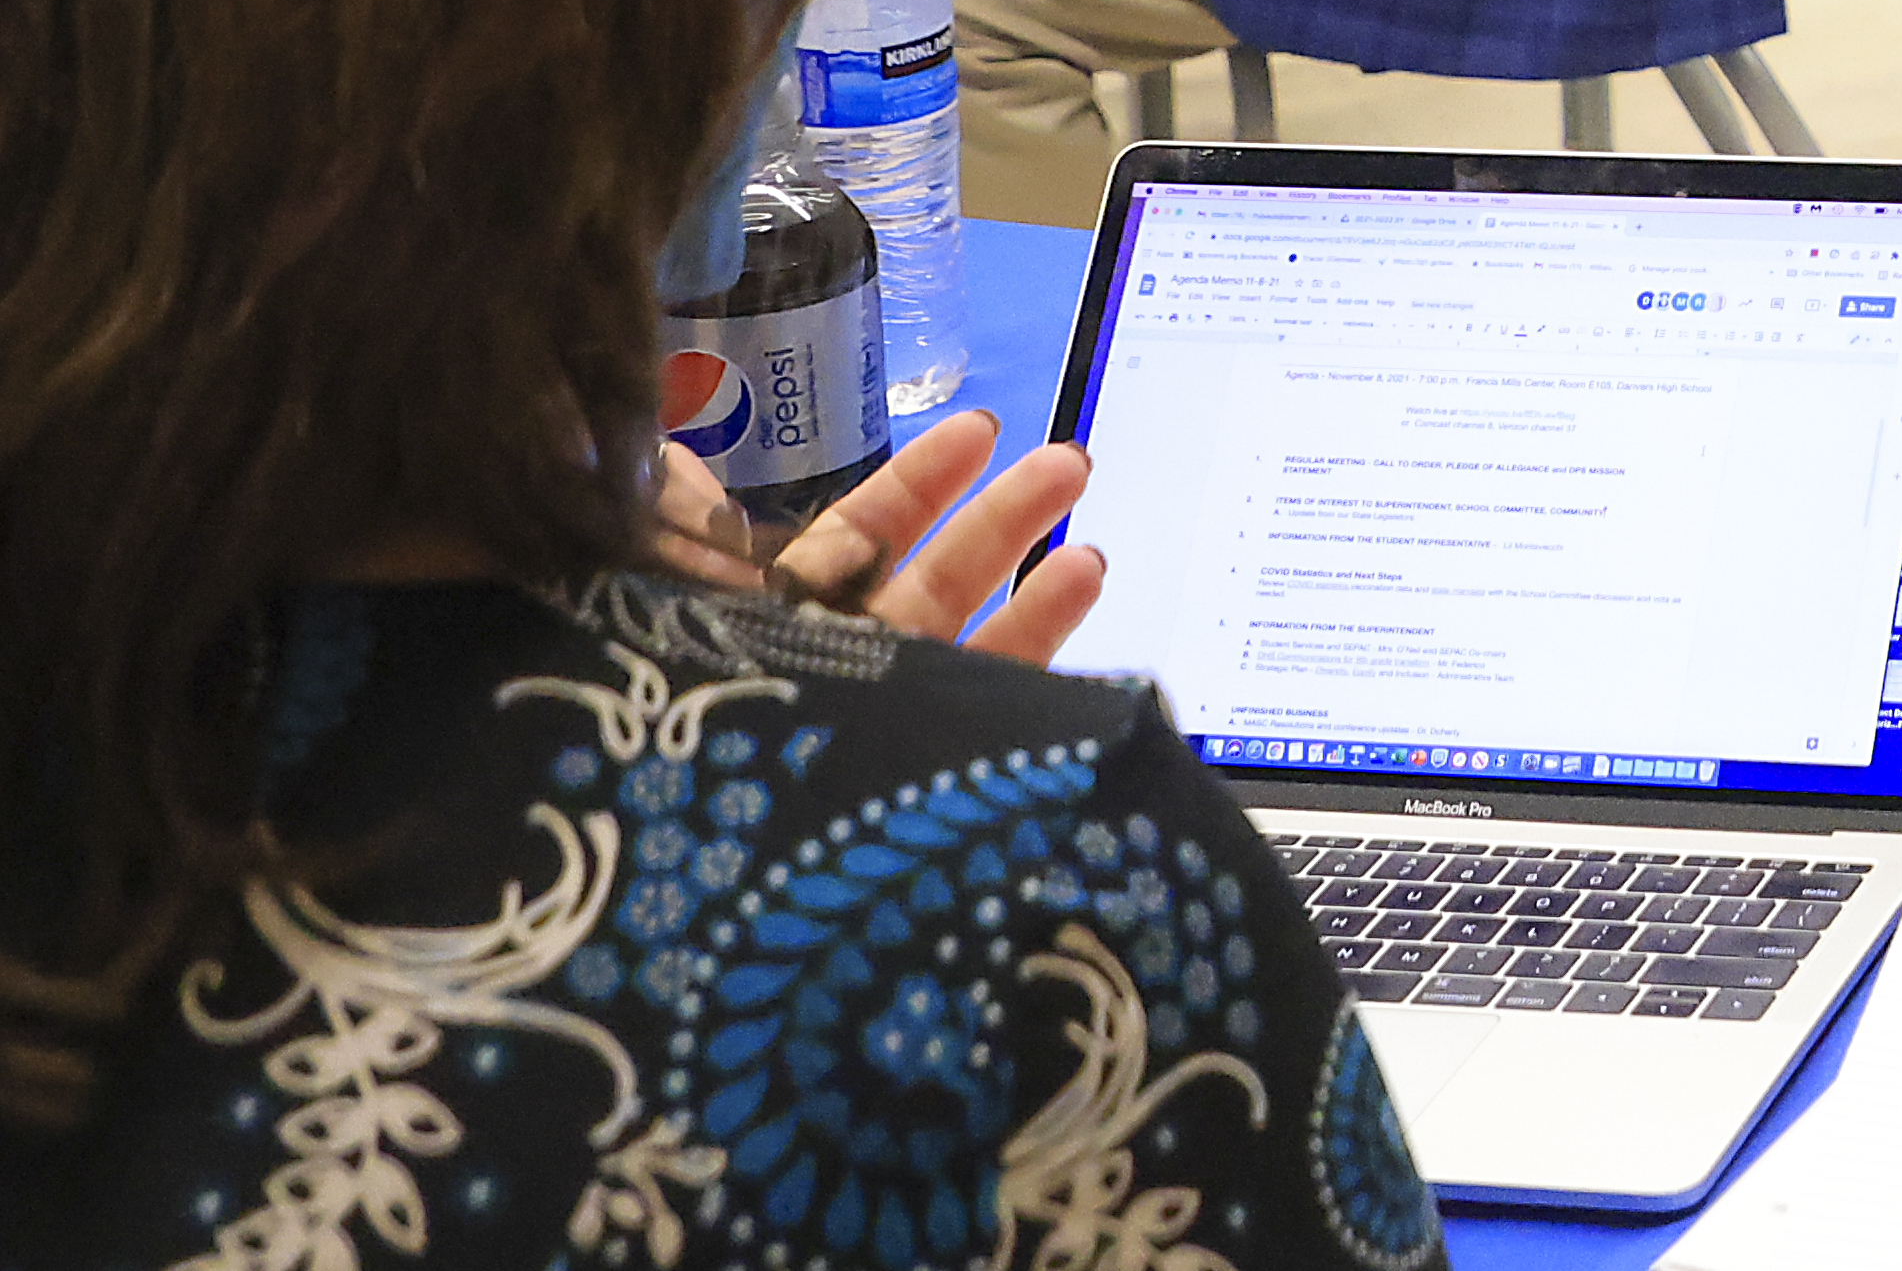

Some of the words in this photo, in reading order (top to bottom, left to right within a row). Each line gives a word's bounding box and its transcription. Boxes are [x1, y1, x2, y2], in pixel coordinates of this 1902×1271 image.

[1208, 188, 1222, 196] File
[1232, 188, 1248, 197] Edit
[1170, 273, 1208, 287] Agenda
[1211, 274, 1242, 284] Memo
[1166, 291, 1180, 299] File
[1269, 293, 1298, 302] Format
[1335, 296, 1370, 305] Add-ons
[1859, 301, 1886, 312] Share
[1284, 370, 1318, 381] Agenda
[1328, 371, 1374, 381] November
[1387, 373, 1408, 383] 2021
[1465, 376, 1498, 385] Francis
[1558, 379, 1586, 388] Room
[1616, 381, 1654, 390] Danvers
[1656, 382, 1678, 393] High
[1680, 383, 1712, 392] School
[764, 348, 808, 446] pepsi
[1282, 466, 1332, 475] STATEMENT
[1284, 455, 1324, 464] REGULAR
[1327, 456, 1366, 466] MEETING
[1373, 458, 1394, 467] CALL
[1398, 459, 1409, 468] TO
[1445, 461, 1480, 470] PLEDGE
[1482, 462, 1495, 471] OF
[1495, 463, 1550, 473] ALLEGIANCE
[1551, 465, 1566, 473] and
[1275, 496, 1302, 505] ITEMS
[1304, 497, 1315, 505] OF
[1317, 497, 1360, 507] INTEREST
[1362, 499, 1373, 507] TO
[1455, 503, 1492, 512] SCHOOL
[1550, 506, 1604, 516] COMMUNITY
[1268, 531, 1327, 541] INFORMATION
[1329, 533, 1355, 542] FROM
[1357, 534, 1374, 543] THE
[1375, 535, 1415, 544] STUDENT
[1417, 536, 1491, 547] REPRESENTATIVE
[1260, 567, 1290, 576] COVID
[1292, 568, 1333, 578] Statistics
[1335, 570, 1352, 579] and
[1354, 571, 1376, 580] Next
[1377, 572, 1402, 582] Steps
[1249, 620, 1308, 630] INFORMATION
[1310, 622, 1336, 631] FROM
[1338, 623, 1355, 632] THE
[1357, 625, 1435, 636] SUPERINTENDENT
[1230, 705, 1284, 715] UNFINISHED
[1285, 708, 1330, 718] BUSINESS
[1404, 798, 1468, 815] MacBook
[1468, 801, 1492, 817] Pro
[1406, 890, 1422, 902] U
[1802, 888, 1838, 897] delete
[1336, 947, 1354, 959] N
[1400, 951, 1420, 962] M
